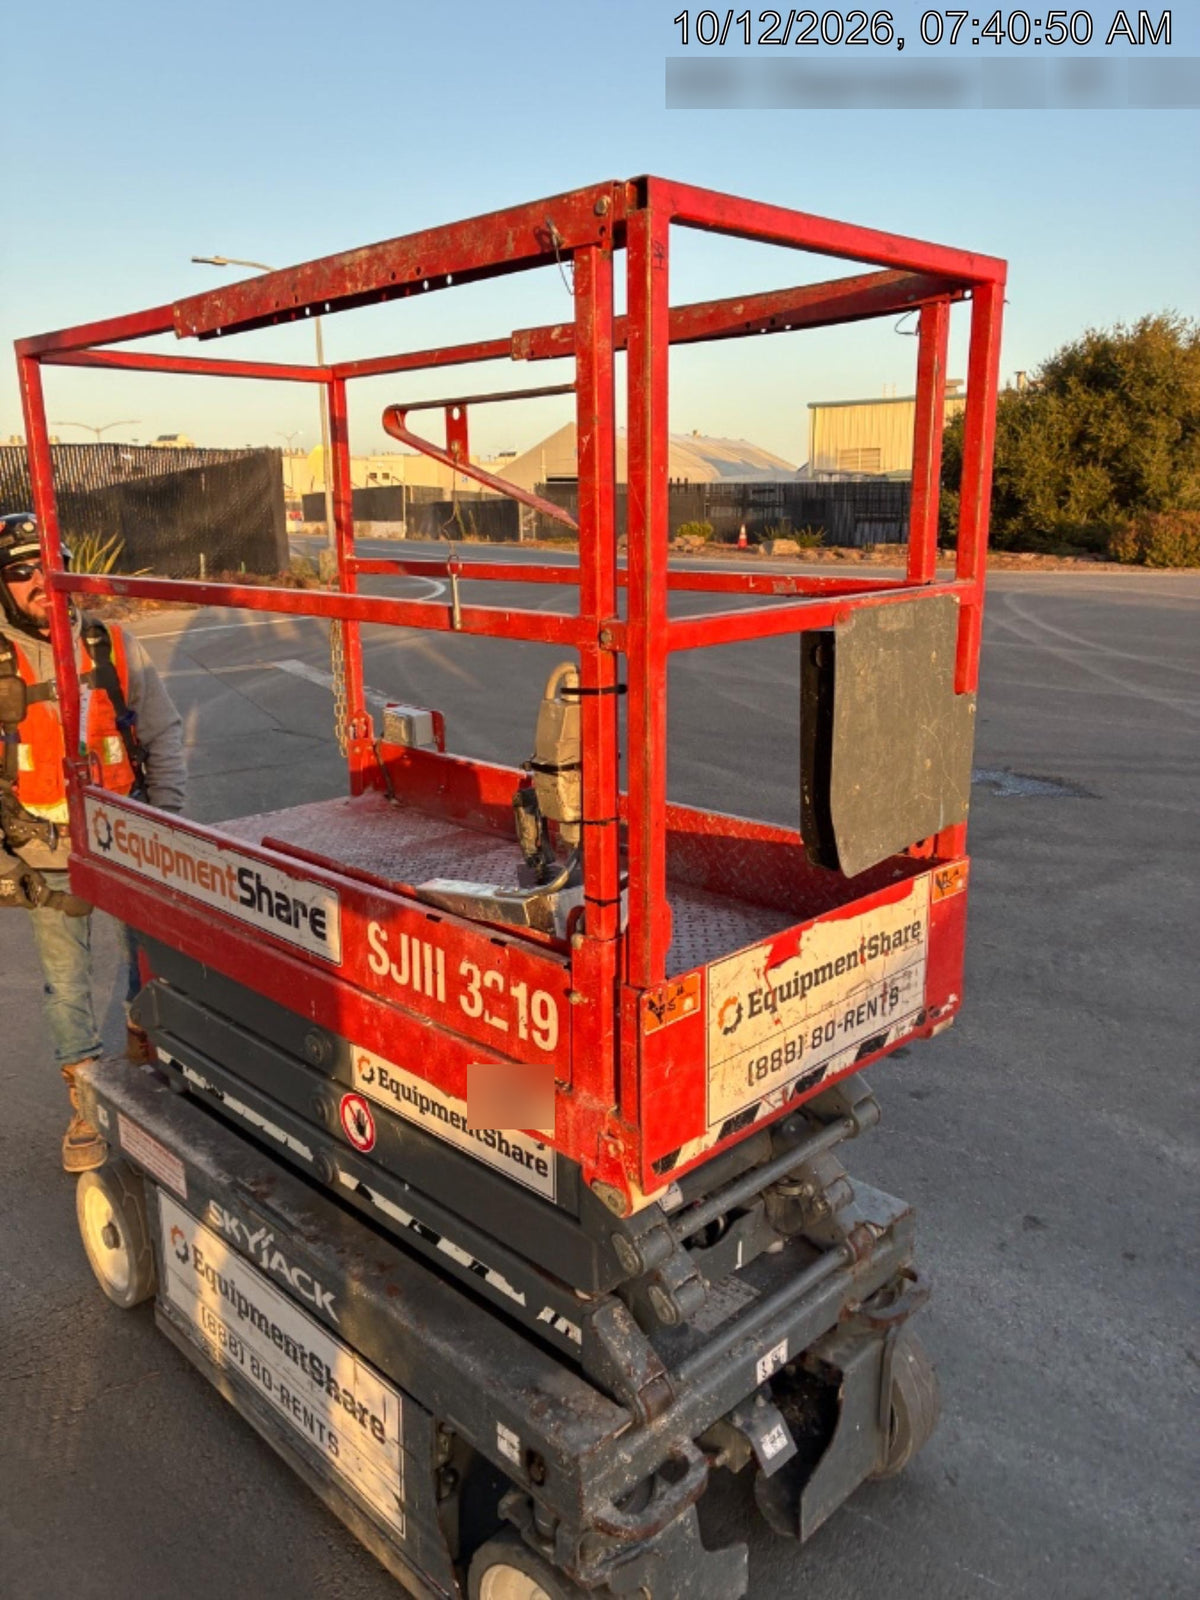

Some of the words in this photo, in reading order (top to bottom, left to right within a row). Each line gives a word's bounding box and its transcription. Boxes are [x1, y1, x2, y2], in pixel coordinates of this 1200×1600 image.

[113, 818, 328, 942] EquipmentShare
[748, 920, 921, 1021] EquipmentShare
[748, 1033, 805, 1087] (888)
[811, 986, 899, 1049] 80-RENTS
[208, 1199, 340, 1324] SKYJACK
[192, 1244, 386, 1445] EquipmentShare
[201, 1305, 245, 1365] (888)
[250, 1357, 340, 1457] 80-RENTS
